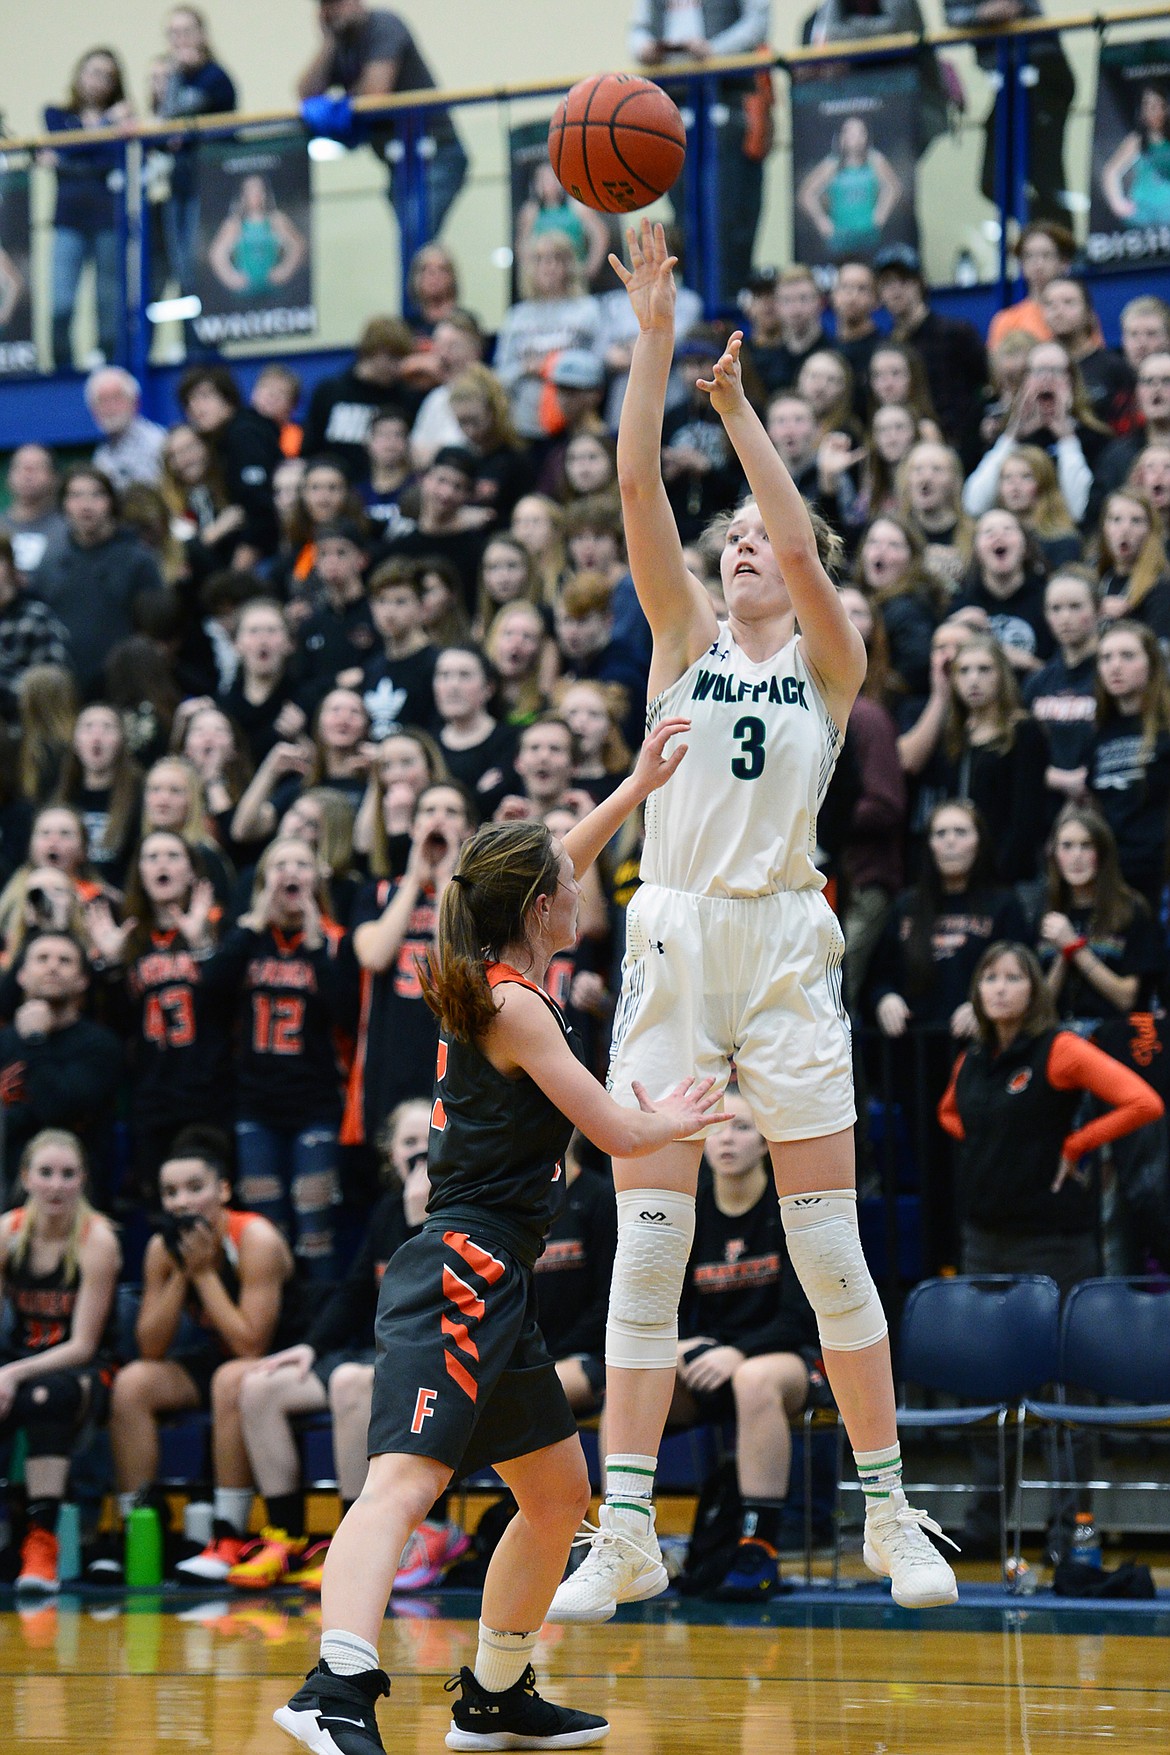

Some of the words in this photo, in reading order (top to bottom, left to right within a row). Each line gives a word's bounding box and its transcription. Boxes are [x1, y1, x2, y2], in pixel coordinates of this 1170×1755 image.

[691, 669, 810, 711] WOLFPACK
[731, 715, 766, 780] 3
[143, 984, 196, 1048] 43
[254, 992, 306, 1055] 12
[410, 1387, 437, 1434] F
